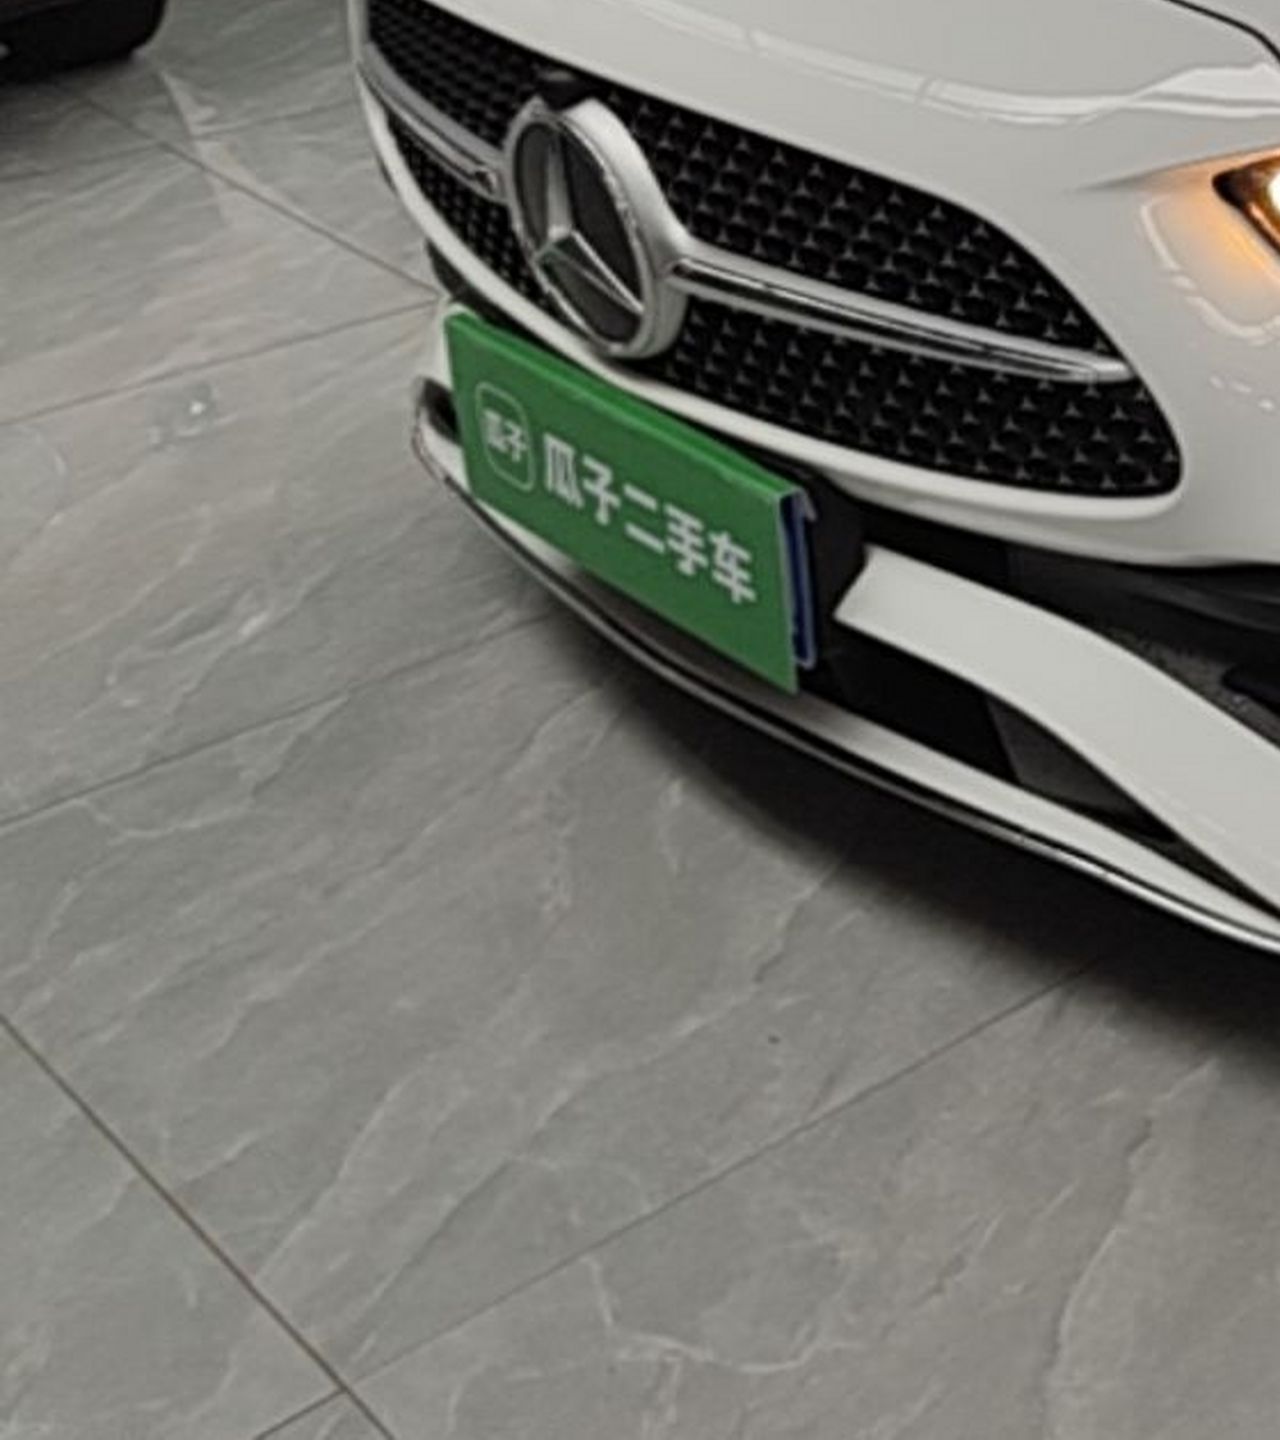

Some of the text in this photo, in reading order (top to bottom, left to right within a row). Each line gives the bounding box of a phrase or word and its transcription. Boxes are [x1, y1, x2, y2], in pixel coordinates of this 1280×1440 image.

[542, 430, 757, 606] 瓜子二手车
